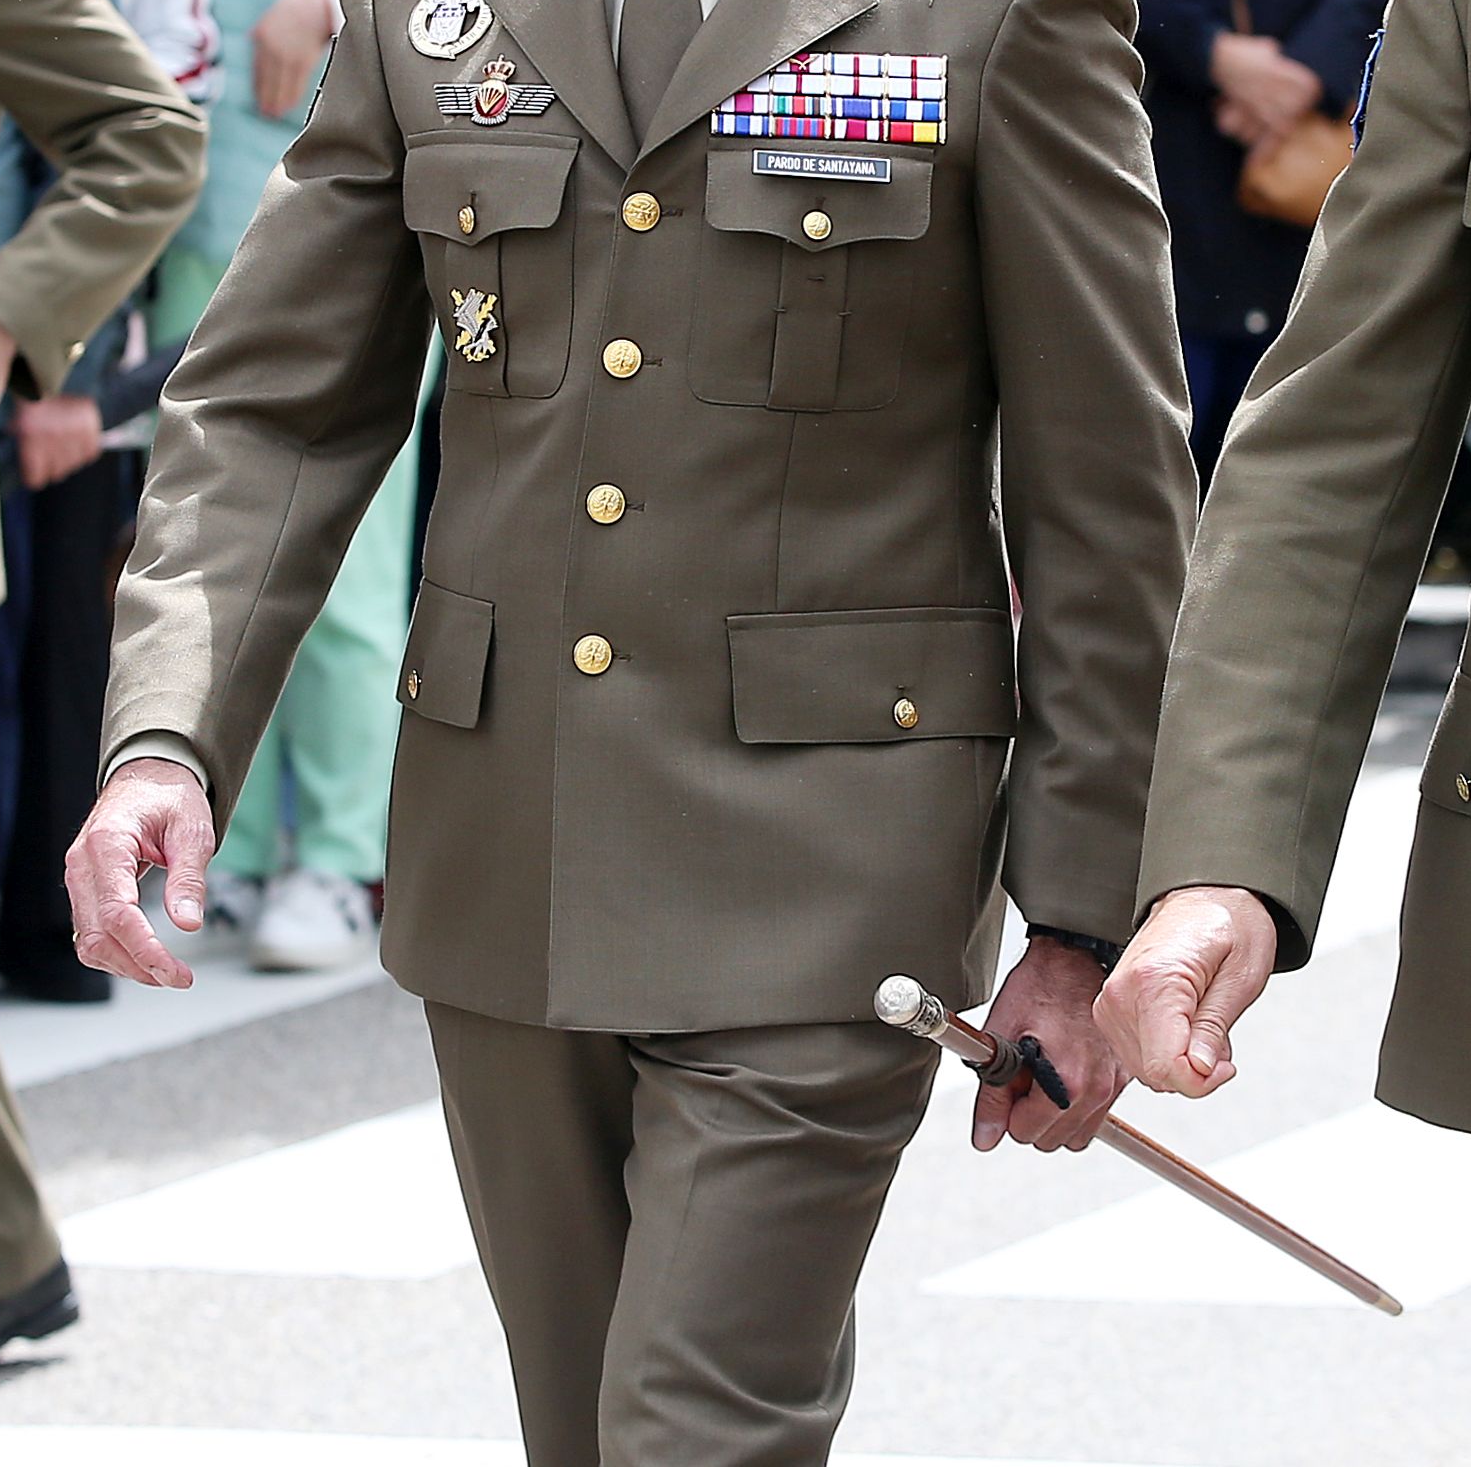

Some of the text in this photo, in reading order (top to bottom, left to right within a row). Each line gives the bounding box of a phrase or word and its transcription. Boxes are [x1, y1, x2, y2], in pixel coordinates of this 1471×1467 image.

[767, 155, 876, 175] PARDO DE SANTAYANA
